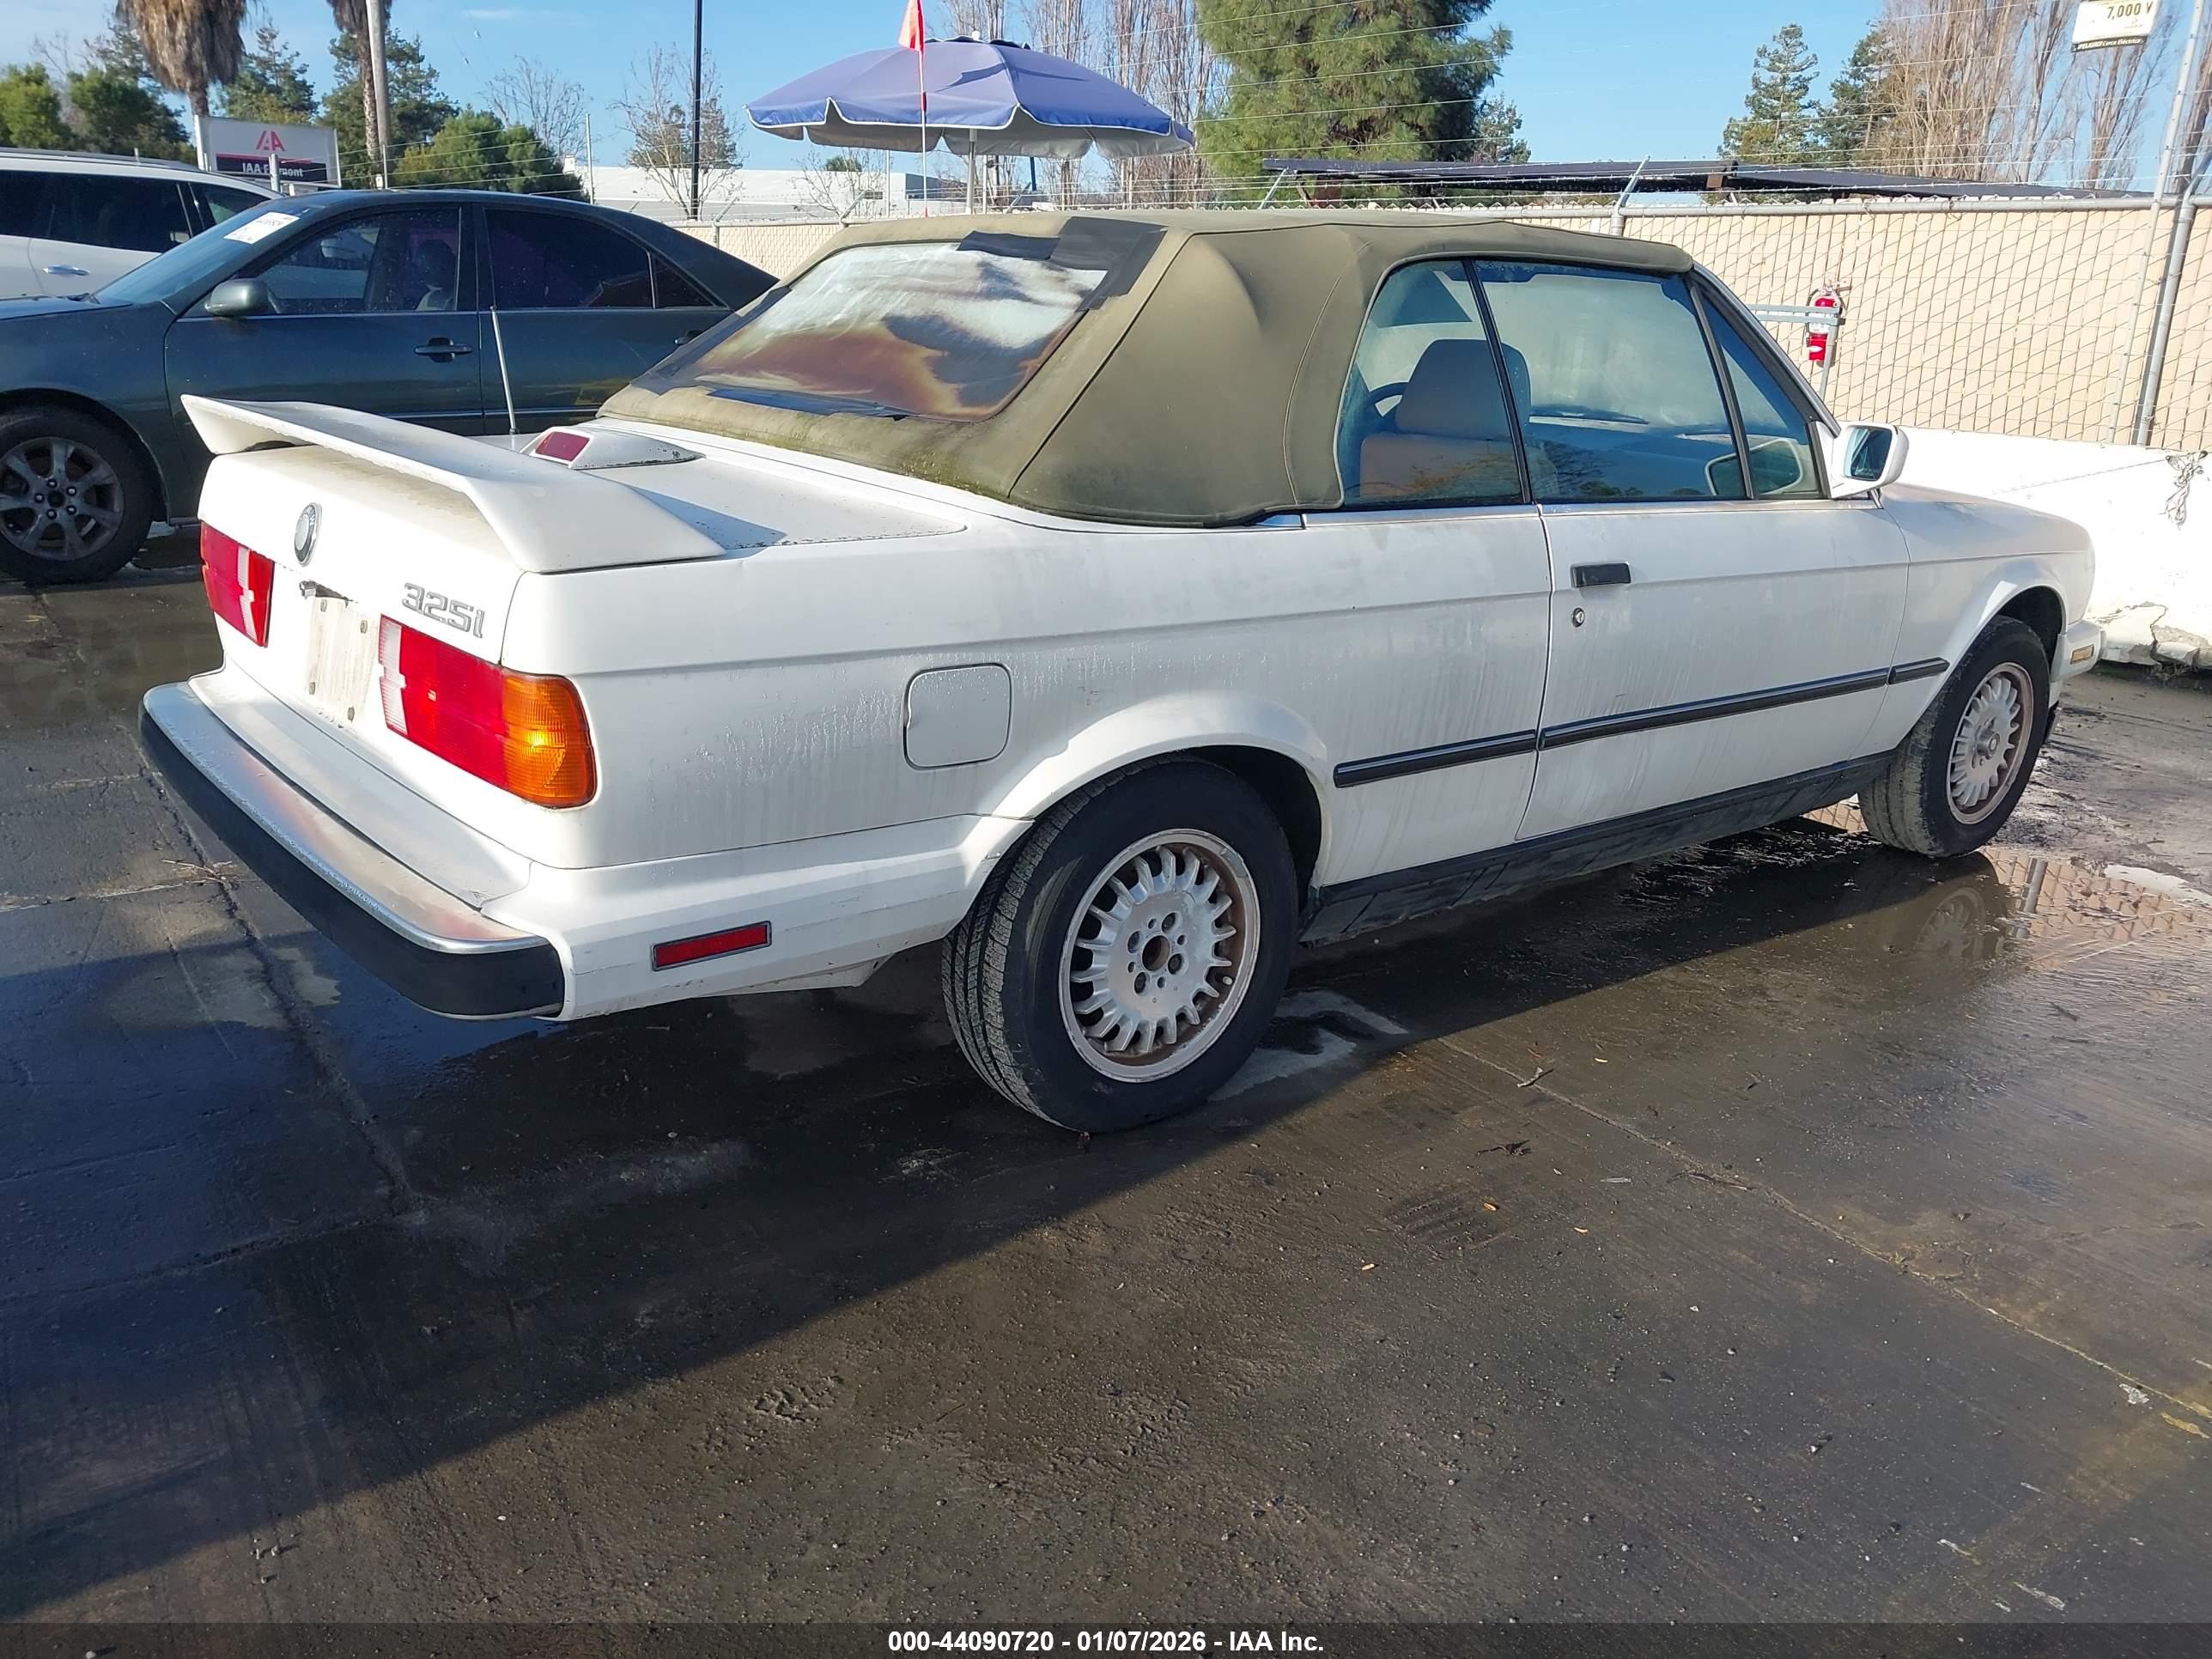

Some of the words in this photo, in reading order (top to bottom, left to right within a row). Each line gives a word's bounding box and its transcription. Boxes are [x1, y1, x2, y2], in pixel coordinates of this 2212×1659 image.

[2107, 3, 2142, 20] 7,000
[2146, 1, 2154, 14] V
[242, 162, 262, 174] IAA
[263, 164, 304, 177] Fmont
